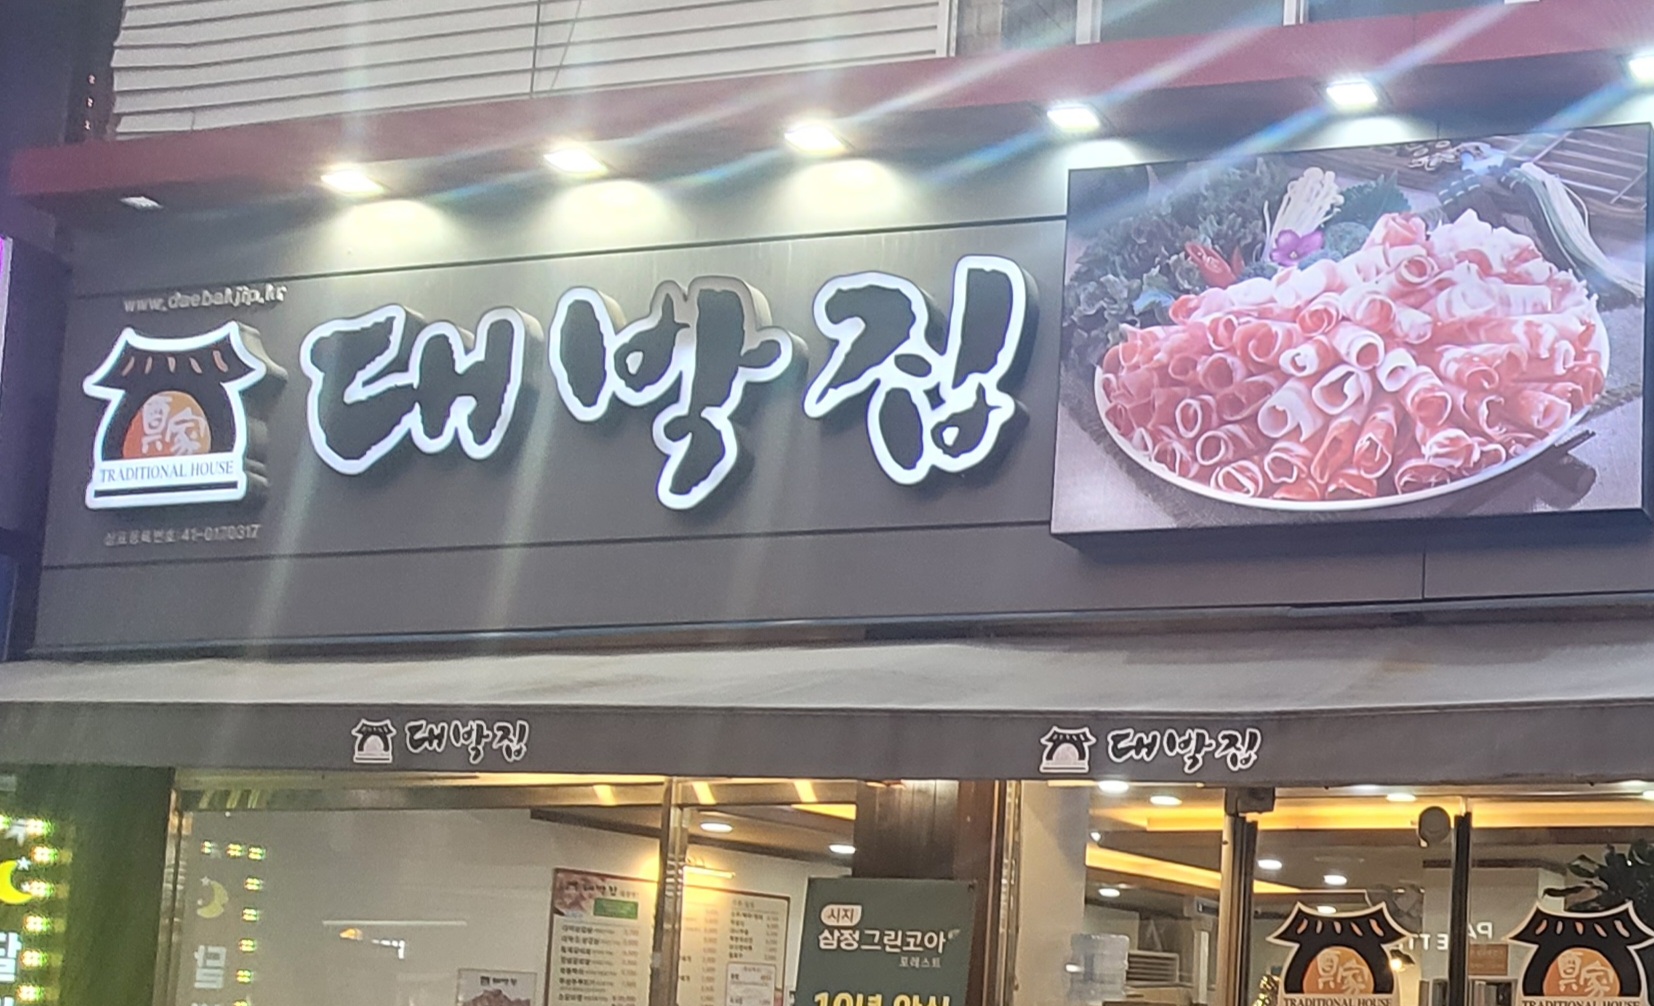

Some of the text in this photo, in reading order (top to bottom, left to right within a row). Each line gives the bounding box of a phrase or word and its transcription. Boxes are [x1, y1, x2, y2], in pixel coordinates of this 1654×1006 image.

[124, 284, 288, 312] www.daebakjip.kr
[300, 253, 1028, 510] 대박집
[100, 460, 234, 483] TRADITIONAL HOUSE
[405, 719, 530, 763] 대박집
[1107, 727, 1263, 773] 대박집
[827, 907, 855, 923] 시지
[818, 929, 946, 955] 삼정그린코아
[899, 957, 941, 968] 포레스트
